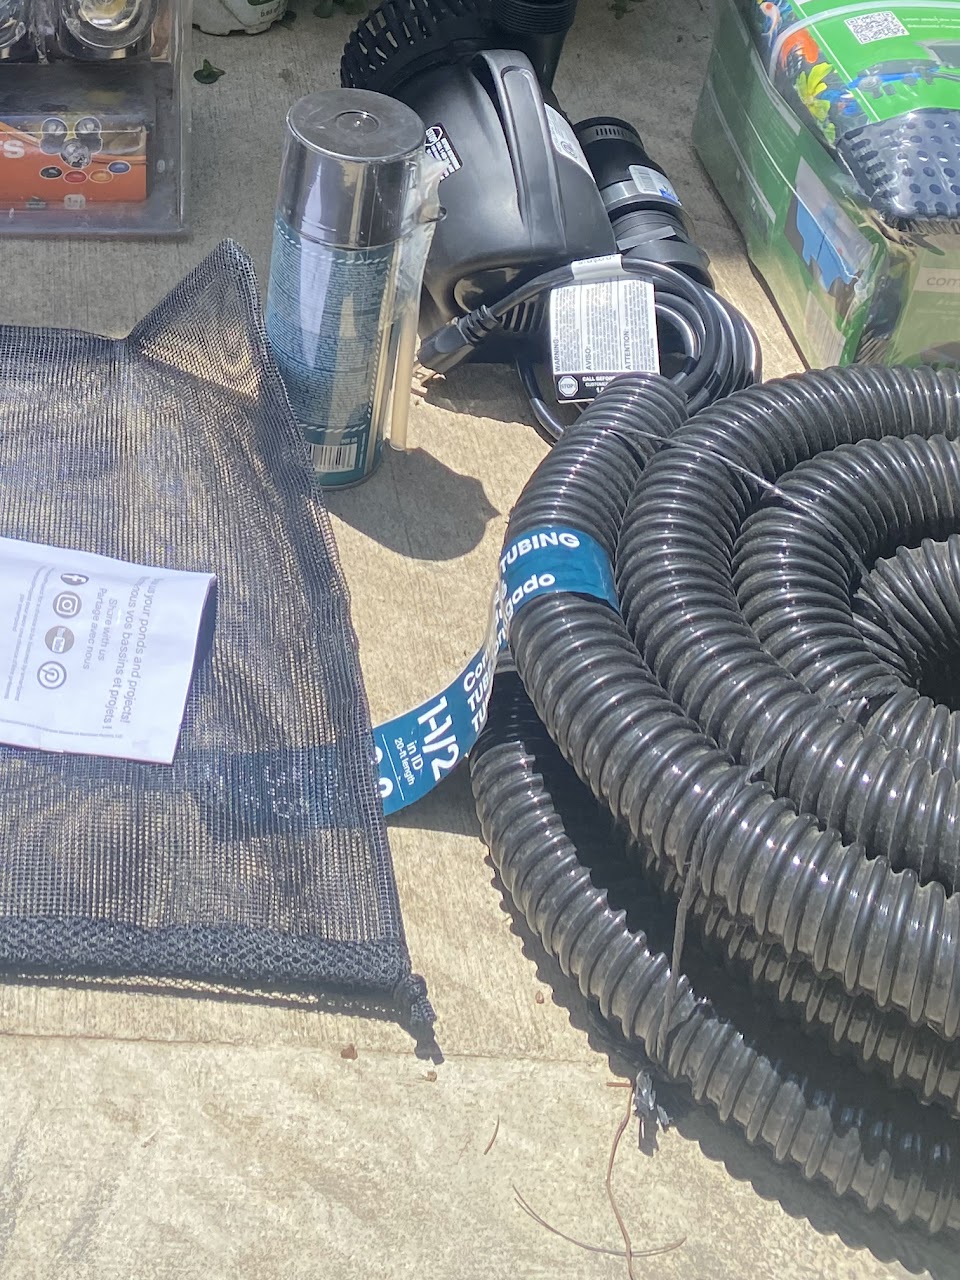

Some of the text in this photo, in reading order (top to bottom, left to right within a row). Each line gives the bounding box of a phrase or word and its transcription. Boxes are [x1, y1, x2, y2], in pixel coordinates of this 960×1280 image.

[623, 327, 632, 371] ATTENTION:
[499, 531, 580, 573] TUBING
[123, 609, 135, 630] vos
[141, 593, 153, 617] your
[82, 587, 107, 670] Partage avec nous
[97, 597, 118, 662] Share with us
[135, 618, 149, 655] ponds
[115, 632, 133, 676] bassins
[131, 657, 142, 679] and
[112, 676, 122, 689] et
[120, 679, 138, 724] projects!
[103, 689, 119, 724] projets
[406, 739, 423, 771] in ID
[417, 695, 460, 782] 1-1/2
[394, 736, 416, 786] 20-ft length
